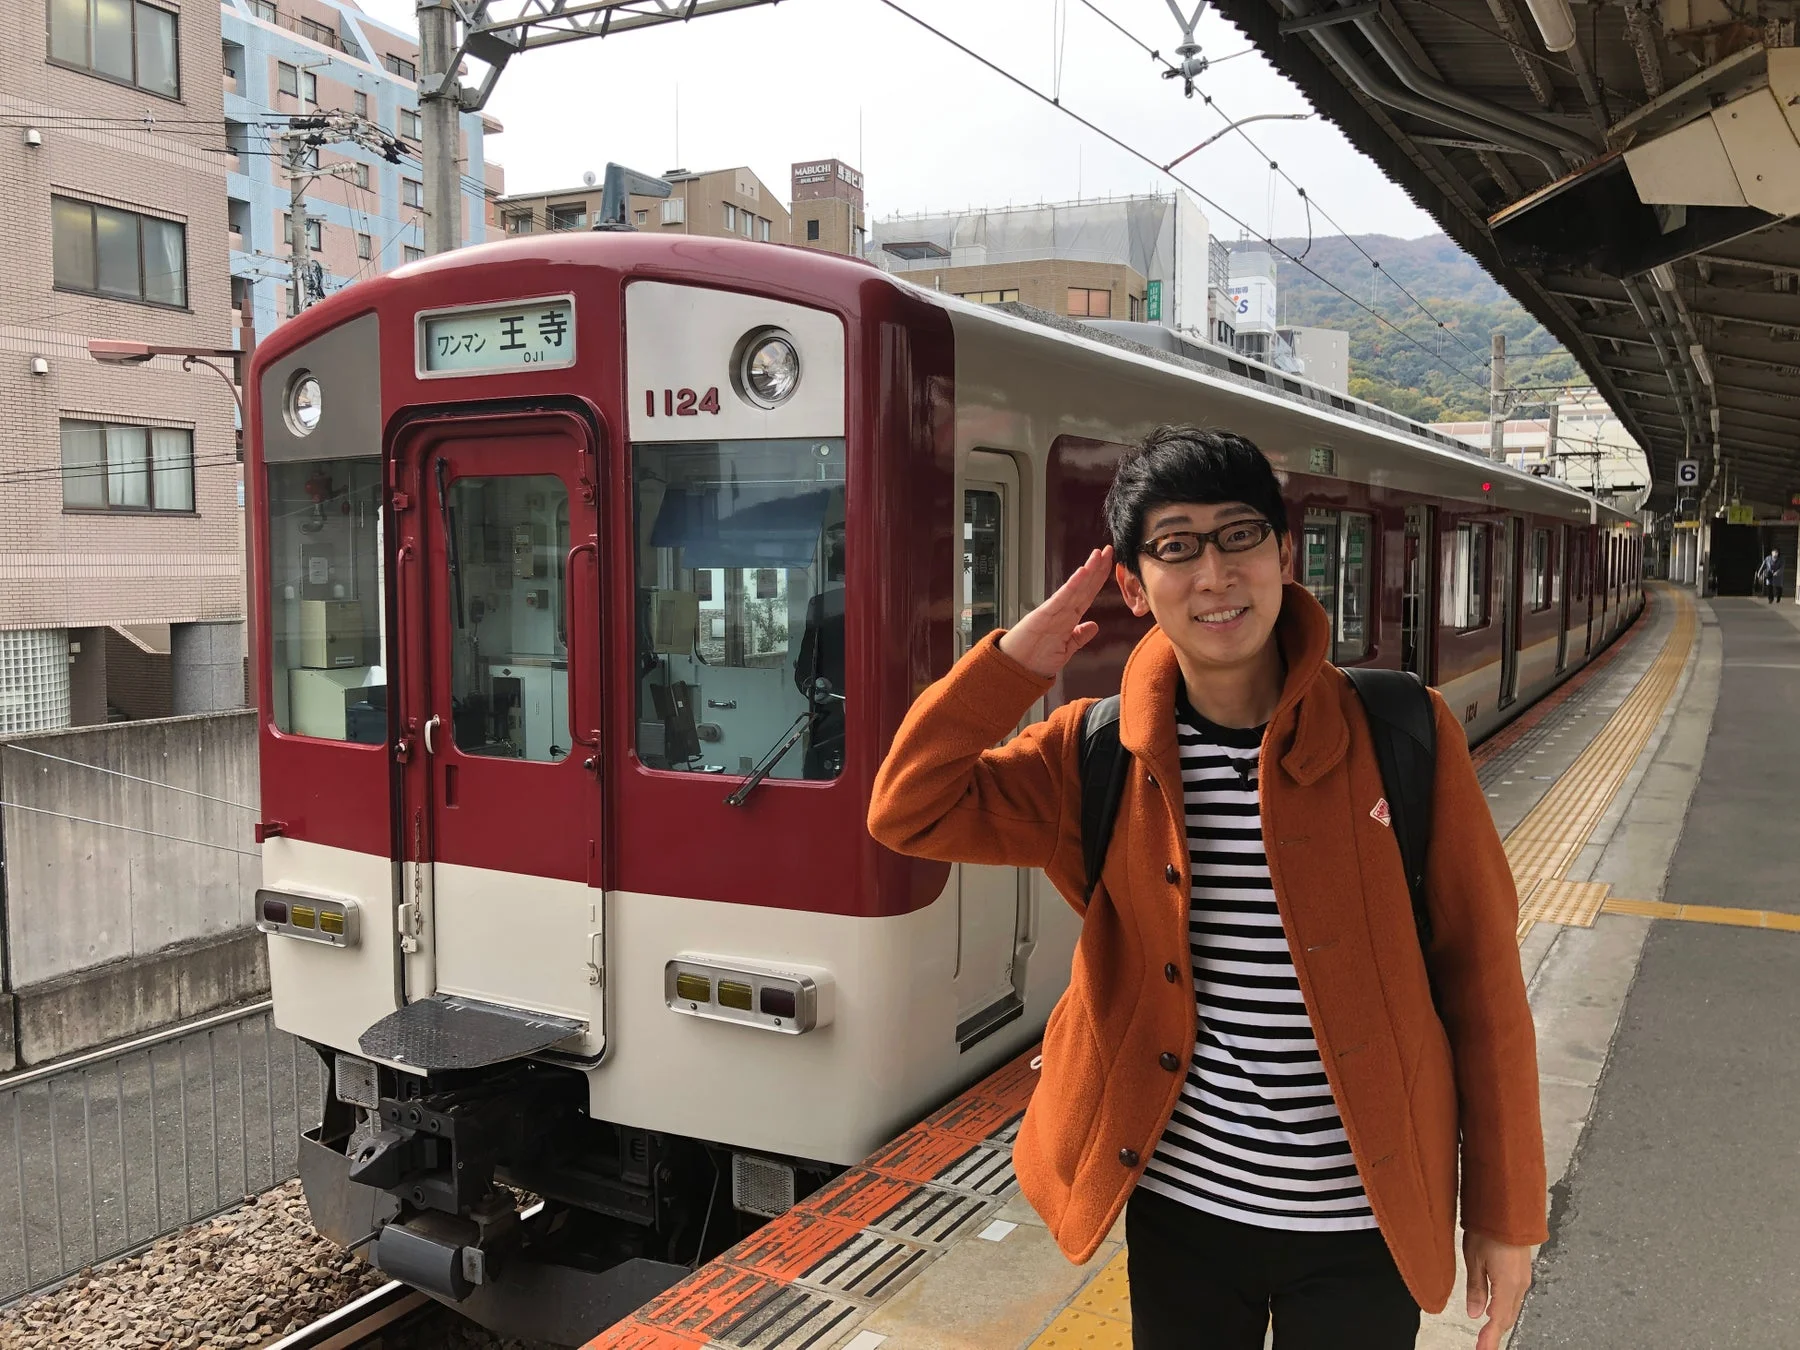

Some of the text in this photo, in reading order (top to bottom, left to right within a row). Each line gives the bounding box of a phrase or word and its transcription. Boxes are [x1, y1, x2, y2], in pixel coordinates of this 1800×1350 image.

[795, 164, 831, 176] MABUCHI
[437, 311, 567, 356] ワンマン 王寺
[523, 351, 544, 363] OJI
[646, 387, 721, 417] 1124
[1681, 464, 1696, 481] 6
